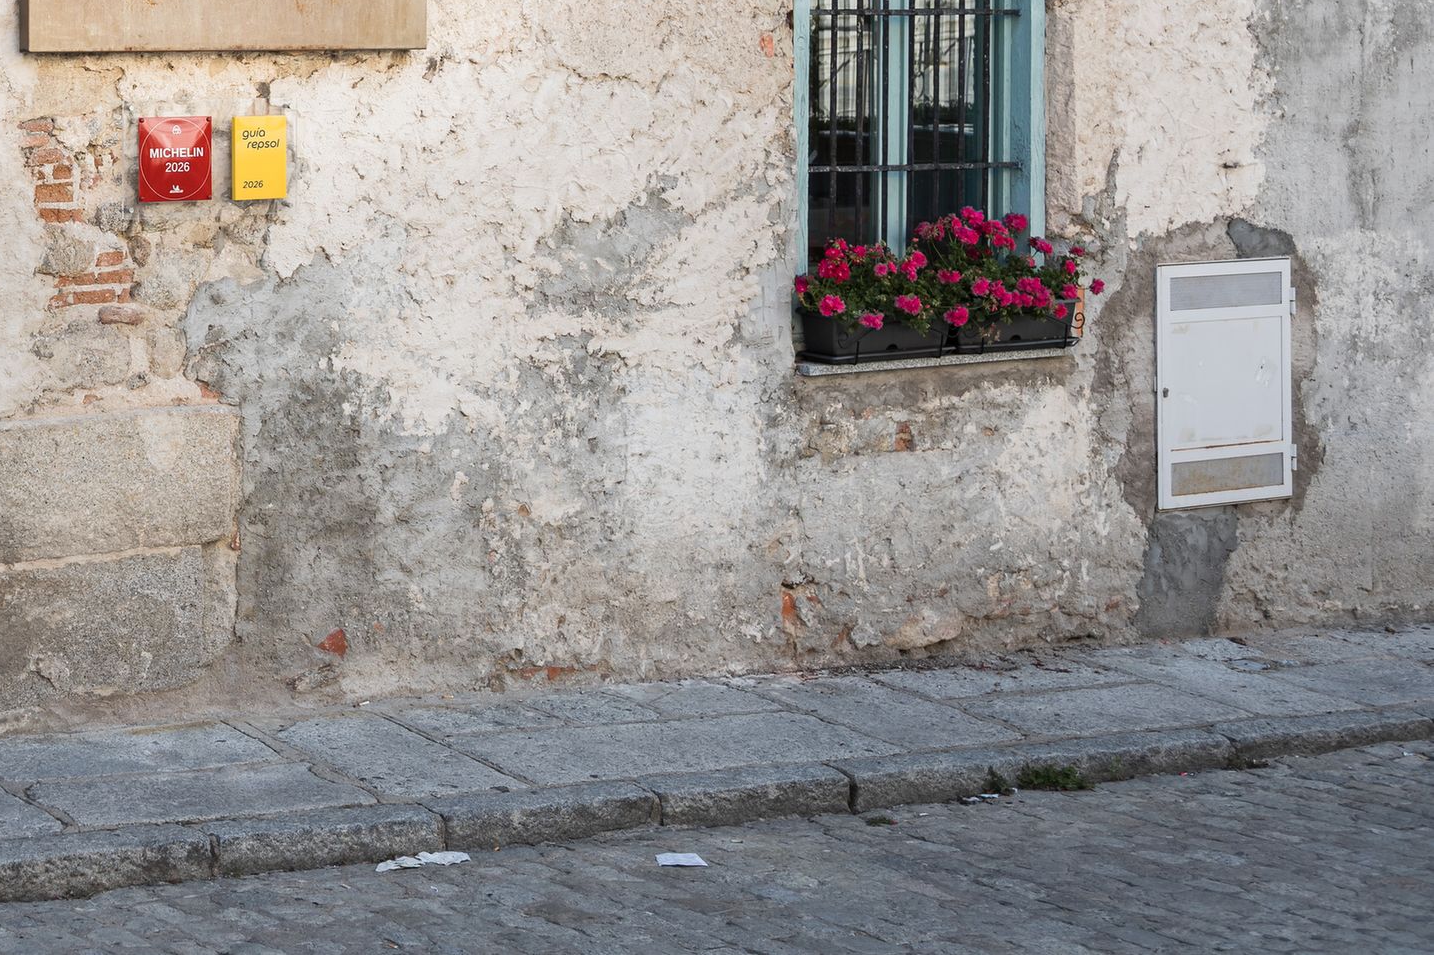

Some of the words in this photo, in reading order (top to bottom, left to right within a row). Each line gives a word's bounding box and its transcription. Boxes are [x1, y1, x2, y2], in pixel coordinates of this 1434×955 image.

[247, 139, 280, 150] repsol
[149, 147, 204, 158] MICHELIN
[165, 162, 190, 173] 2026
[243, 180, 264, 189] 2026
